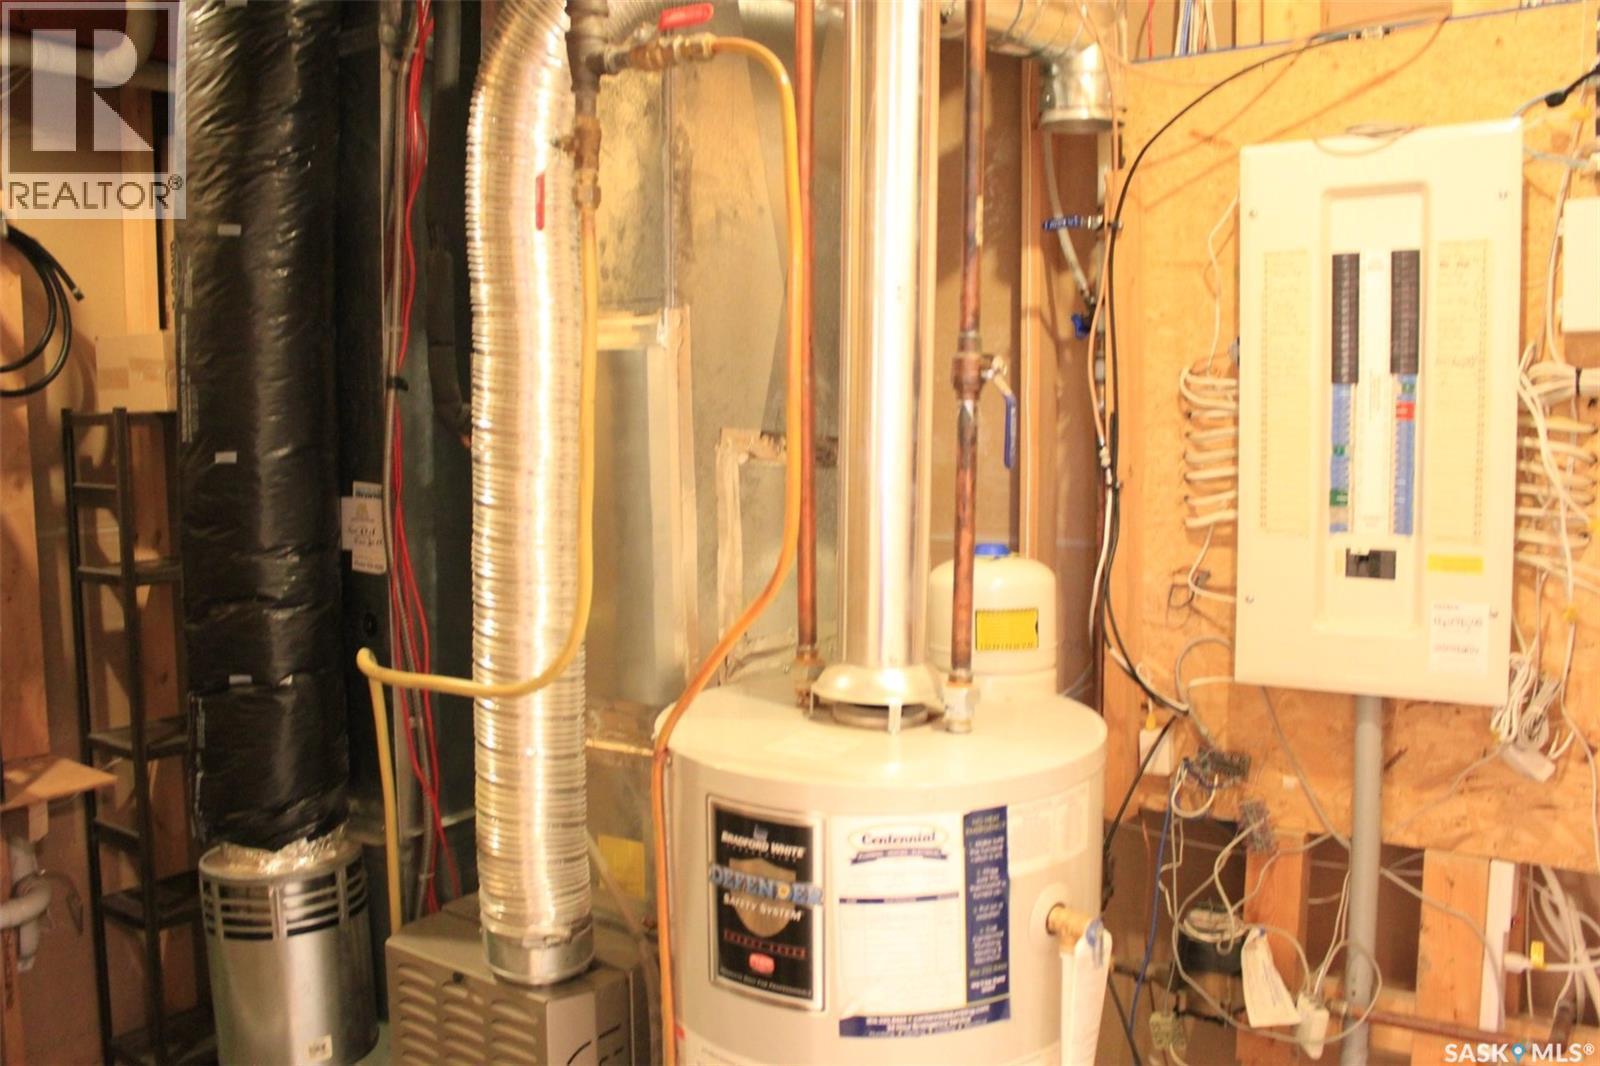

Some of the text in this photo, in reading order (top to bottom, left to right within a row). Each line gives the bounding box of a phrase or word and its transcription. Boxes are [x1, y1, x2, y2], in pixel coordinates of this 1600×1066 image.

[721, 830, 770, 853] BRADFORD
[771, 841, 806, 860] WHITE
[861, 830, 936, 845] Centennial
[709, 863, 822, 907] DEFENDER
[723, 892, 757, 913] SAFETY
